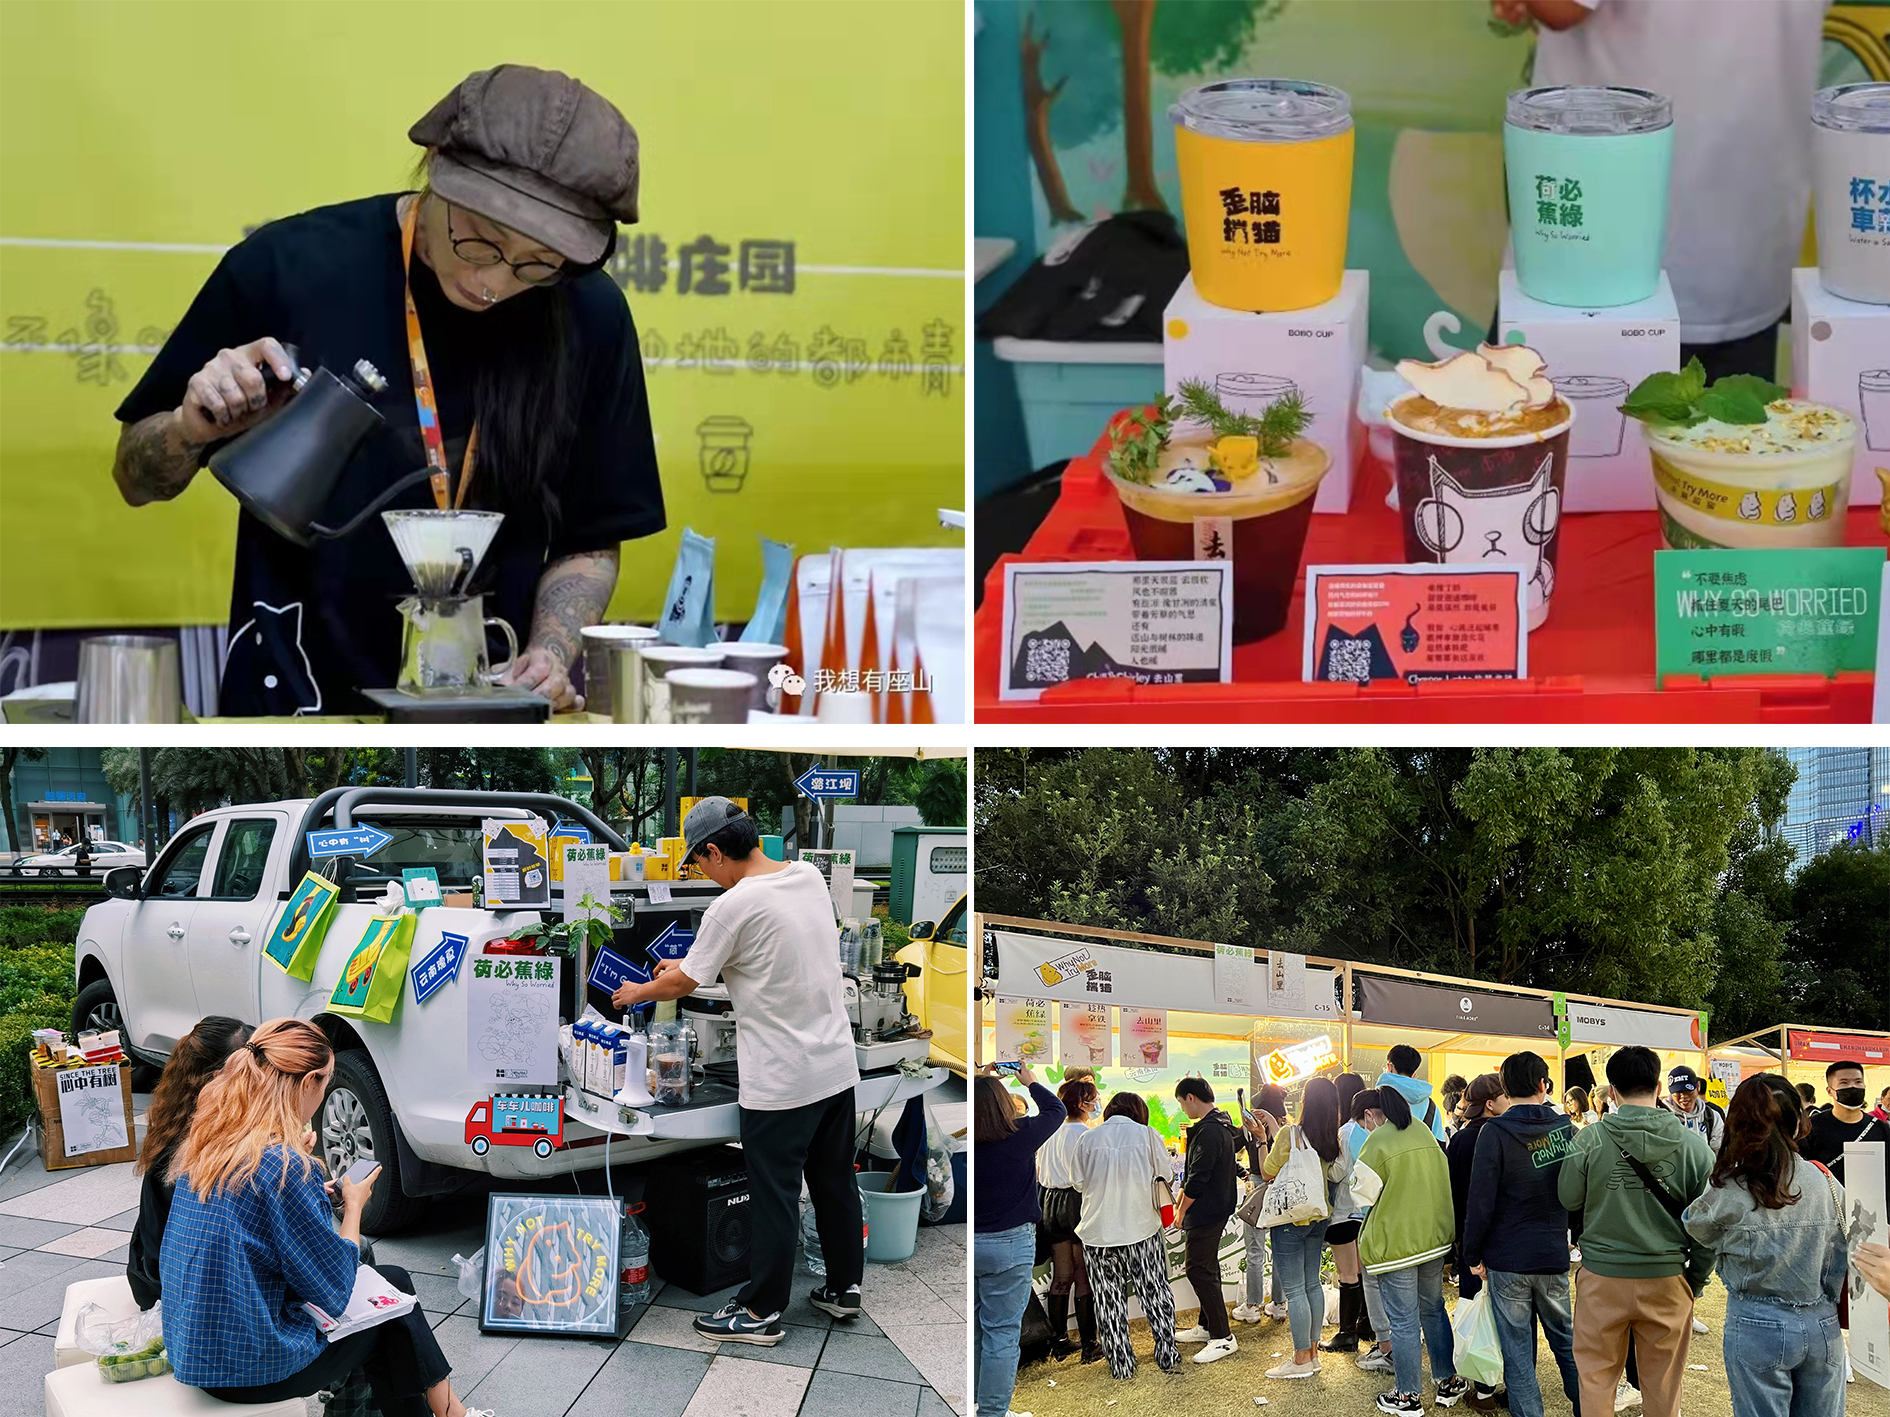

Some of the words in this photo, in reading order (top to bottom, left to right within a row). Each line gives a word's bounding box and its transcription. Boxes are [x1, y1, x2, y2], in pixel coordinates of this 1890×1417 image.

[1219, 186, 1281, 216] 歪脑
[1535, 229, 1549, 242] Why
[1560, 232, 1590, 241] Worried
[1271, 248, 1292, 258] More
[1288, 329, 1313, 338] BOBO
[1315, 330, 1334, 338] CUP
[1621, 328, 1642, 337] BOBO
[1643, 328, 1666, 337] CUP
[1682, 480, 1697, 496] Try
[1698, 487, 1729, 503] More
[1203, 530, 1226, 559] 去
[1695, 572, 1748, 586] 不要焦虑
[1677, 589, 1722, 618] WHY
[1731, 588, 1760, 618] SO
[1768, 587, 1868, 617] WORRIED
[1076, 959, 1098, 972] More
[506, 980, 520, 991] Why
[521, 980, 529, 988] So
[530, 980, 555, 989] Worried
[1314, 1004, 1331, 1012] C-15
[1136, 1016, 1162, 1025] 去山里
[1576, 1016, 1606, 1026] MOBYS
[1538, 1024, 1550, 1032] C-14
[60, 1071, 80, 1080] SINCE
[82, 1069, 95, 1077] THE
[98, 1067, 117, 1075] TREE
[61, 1073, 118, 1094] 心中有树
[497, 1100, 555, 1113] 车车儿咖啡
[503, 1236, 516, 1273] WHY
[514, 1215, 544, 1234] NOT
[576, 1228, 602, 1251] TRY
[584, 1255, 608, 1298] MORE
